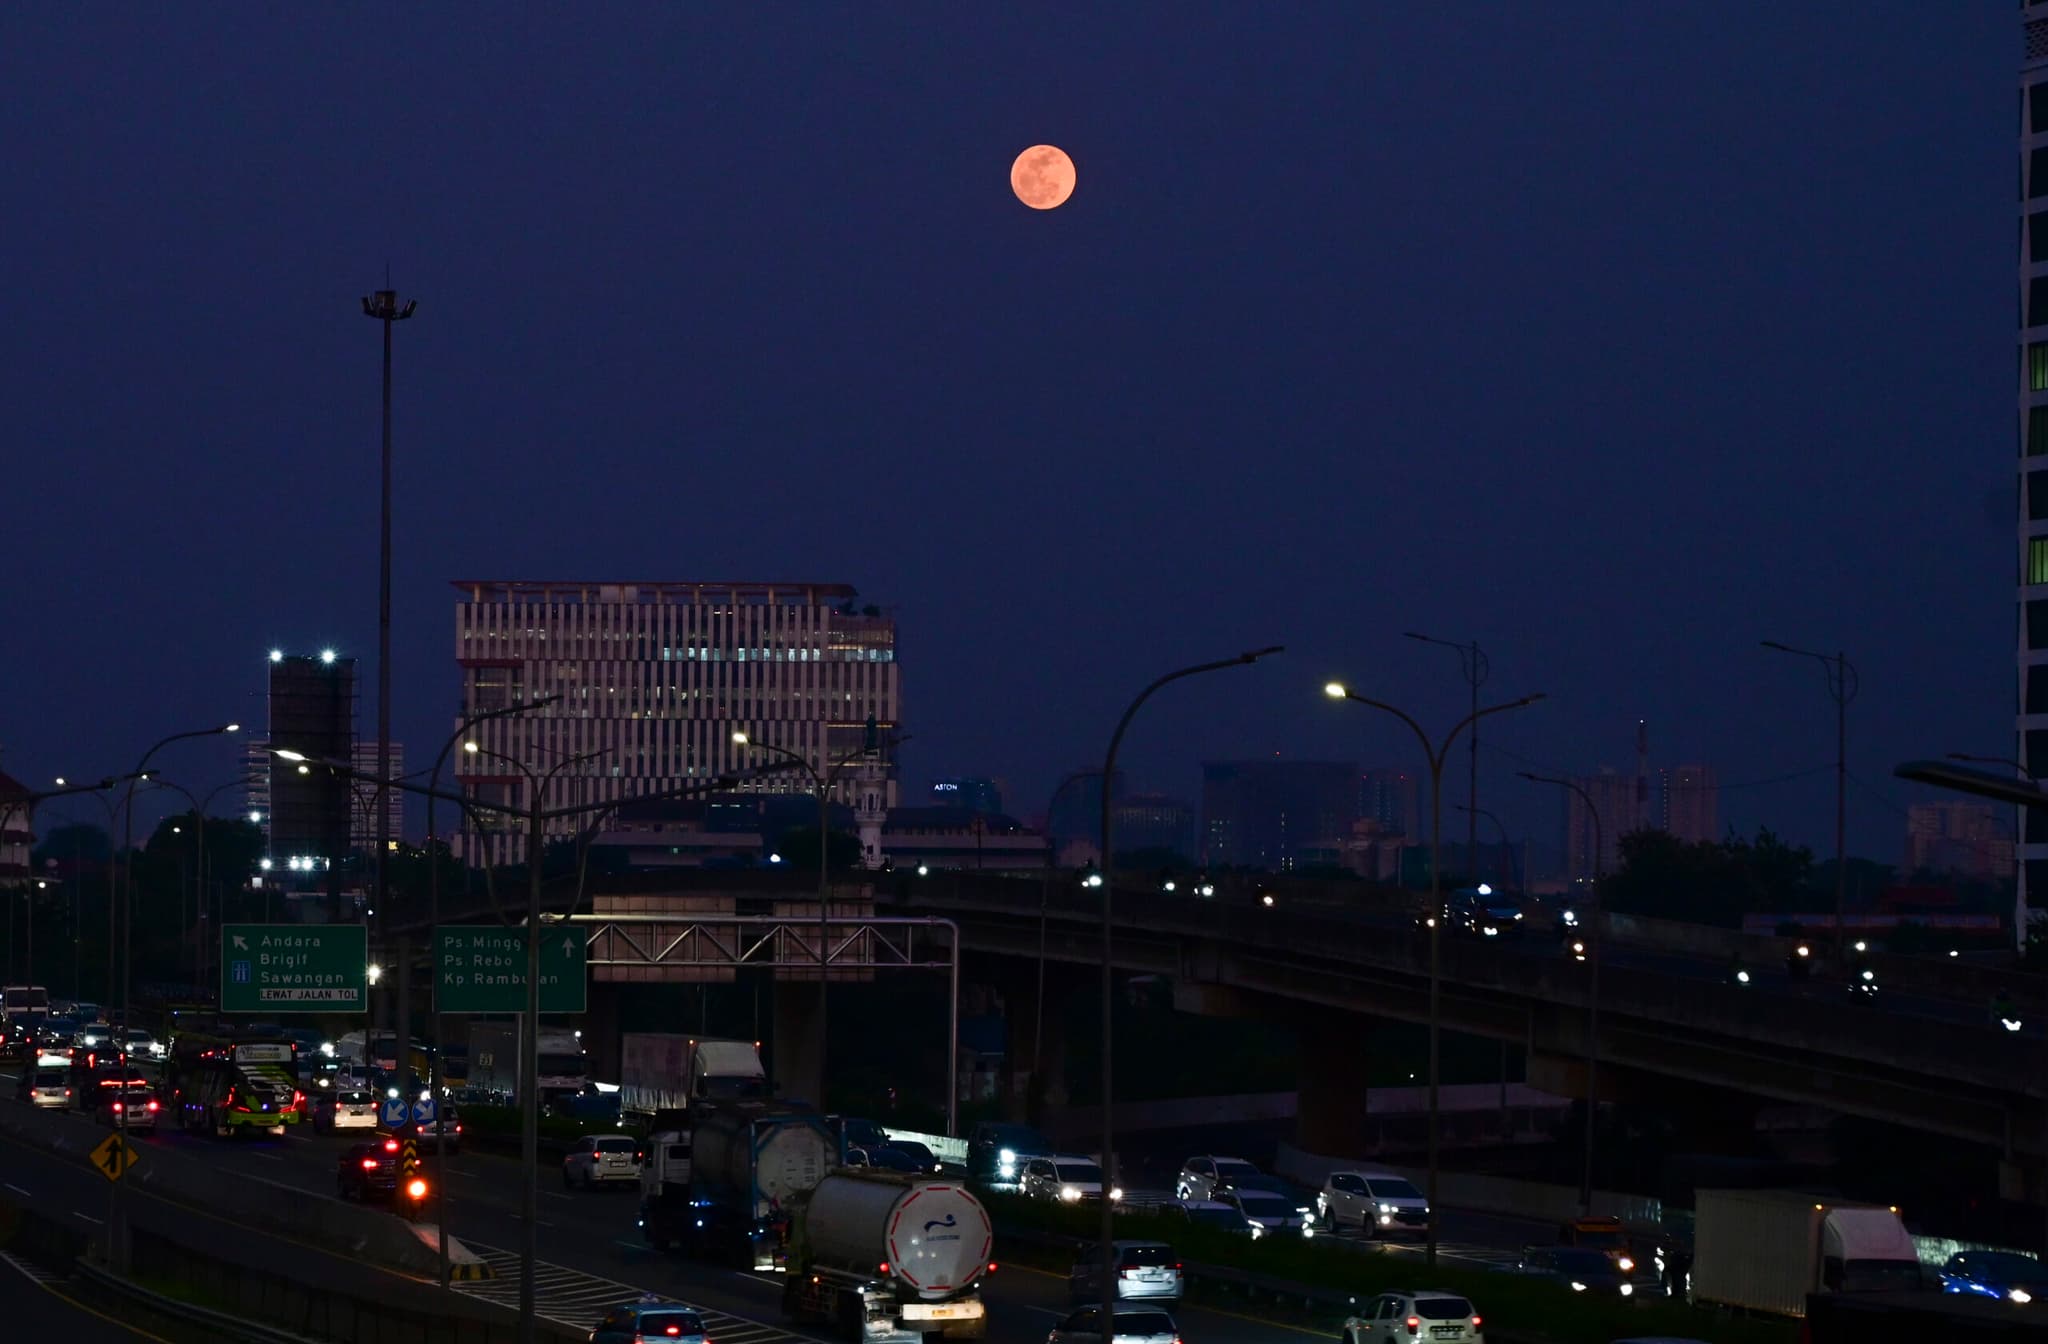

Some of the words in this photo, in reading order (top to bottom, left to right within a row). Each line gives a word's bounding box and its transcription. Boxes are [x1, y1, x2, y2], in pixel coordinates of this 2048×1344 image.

[934, 783, 958, 791] ASTON
[261, 935, 321, 947] Andara
[473, 936, 522, 952] Mingg
[260, 953, 308, 969] Brigif
[473, 954, 513, 967] Rebo
[261, 971, 345, 987] Sawangan
[474, 973, 558, 985] Rambuan
[260, 990, 293, 999] LEWAT
[298, 990, 332, 999] JALAN
[339, 990, 356, 999] TOL
